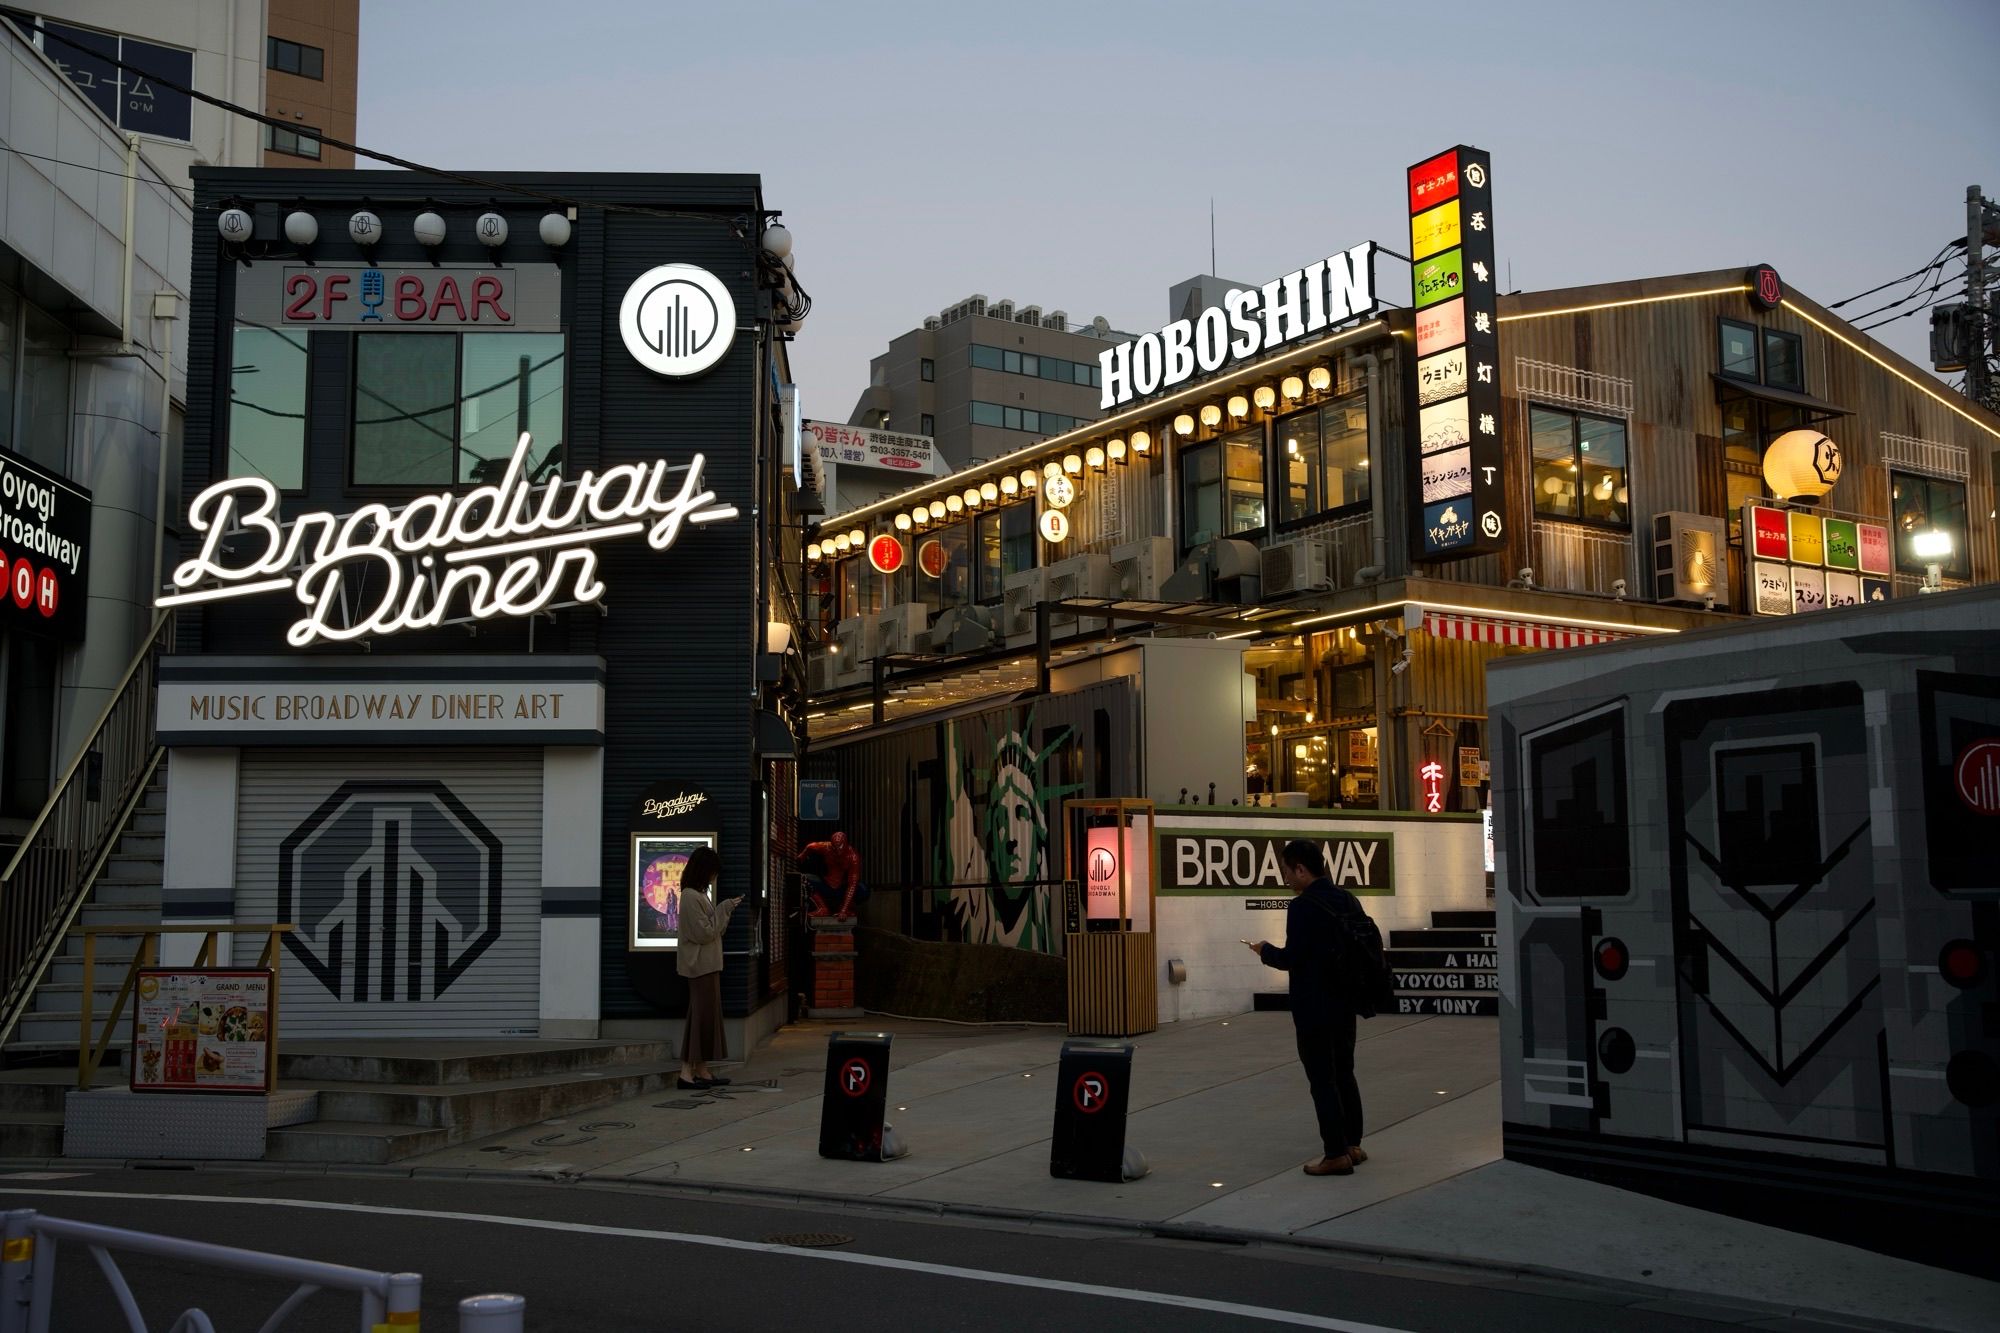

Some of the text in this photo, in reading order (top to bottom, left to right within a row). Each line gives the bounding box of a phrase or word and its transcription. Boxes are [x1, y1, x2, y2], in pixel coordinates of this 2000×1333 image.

[285, 274, 511, 321] 2F BAR
[1099, 240, 1376, 411] HOBOSHIN
[1423, 358, 1462, 385] ウミドリ
[160, 431, 738, 597] Broadway
[286, 544, 607, 648] Diner
[1761, 576, 1788, 592] ウミドリ
[189, 693, 565, 721] MUSIC BROADWAY DINER ART
[643, 791, 708, 814] Broadway
[656, 803, 696, 819] Diner
[1175, 837, 1380, 887] BROAWAY
[1445, 953, 1459, 968] A
[215, 983, 266, 991] GRAND MENU
[1394, 973, 1466, 989] YOYOGI
[1399, 998, 1425, 1014] BY
